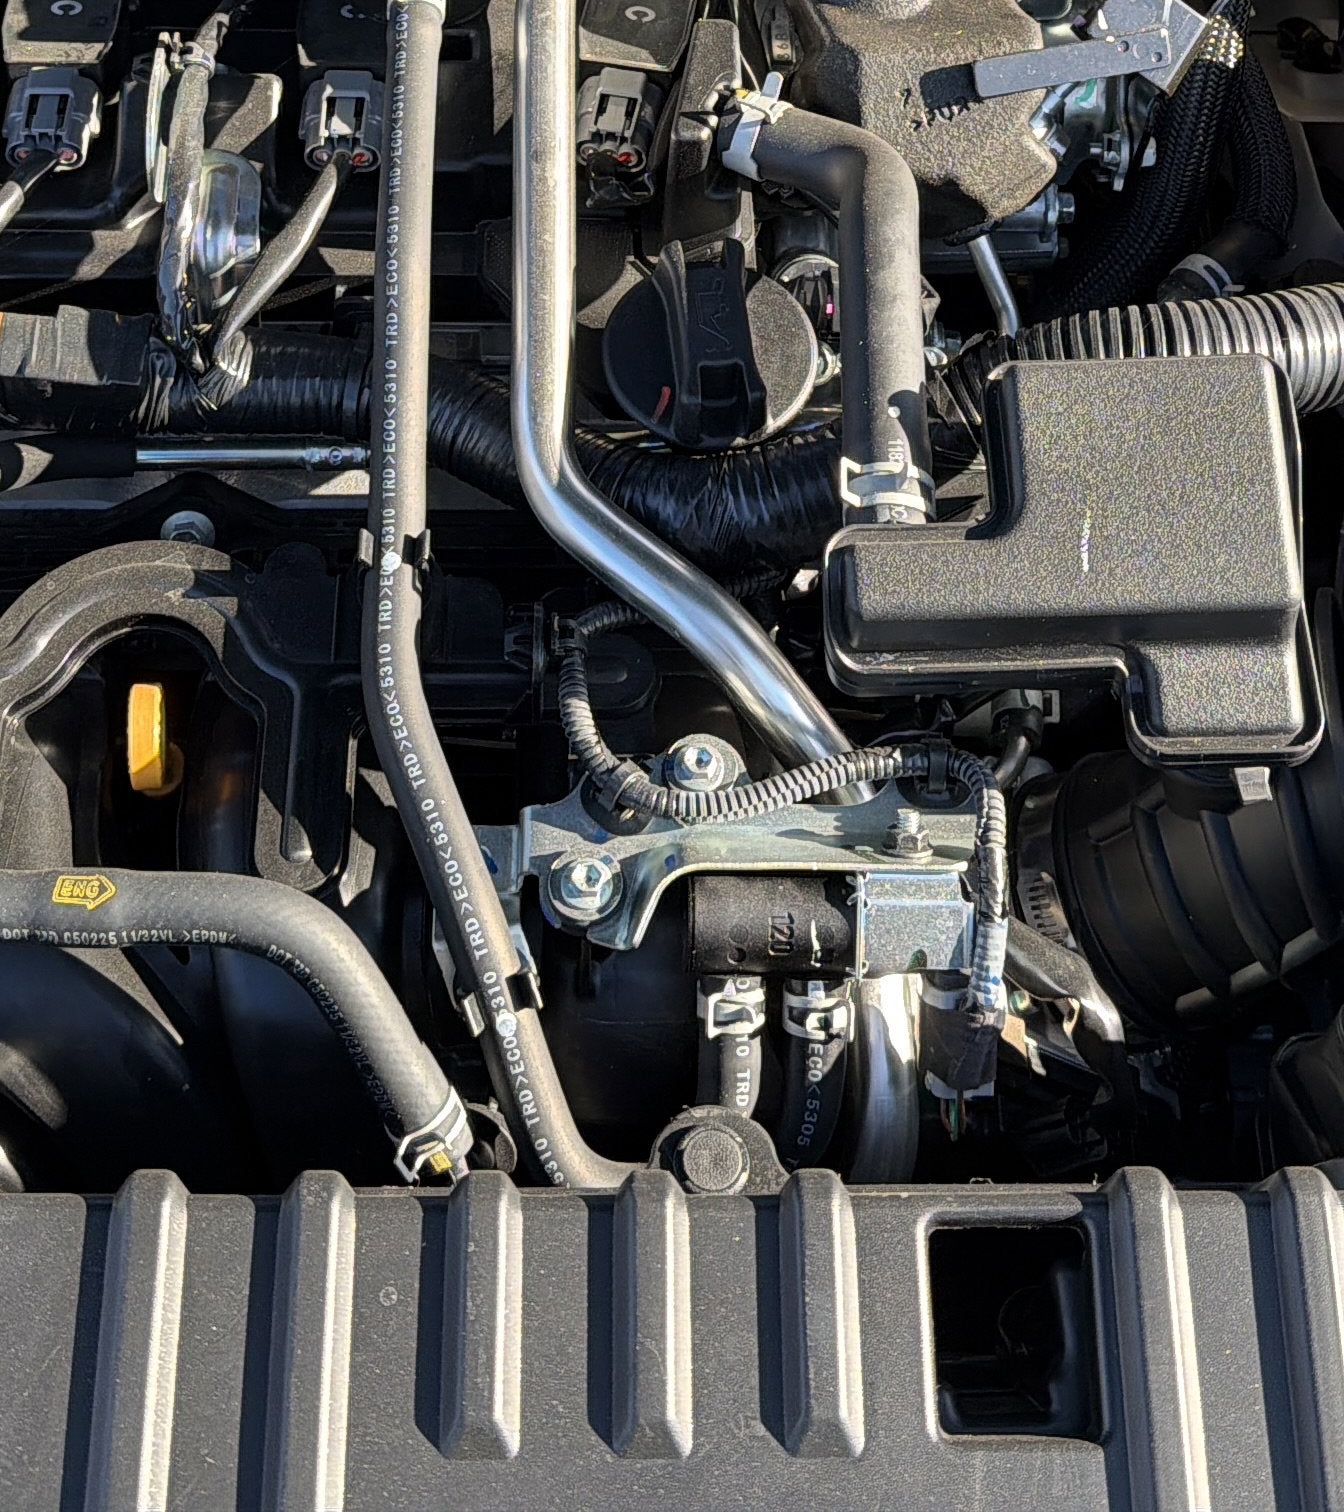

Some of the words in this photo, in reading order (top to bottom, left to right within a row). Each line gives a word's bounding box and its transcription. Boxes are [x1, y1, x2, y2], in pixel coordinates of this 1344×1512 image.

[59, 878, 102, 898] ENG
[768, 911, 795, 956] 120
[483, 971, 540, 1128] TRD>ECO5310
[735, 1068, 751, 1107] TRD
